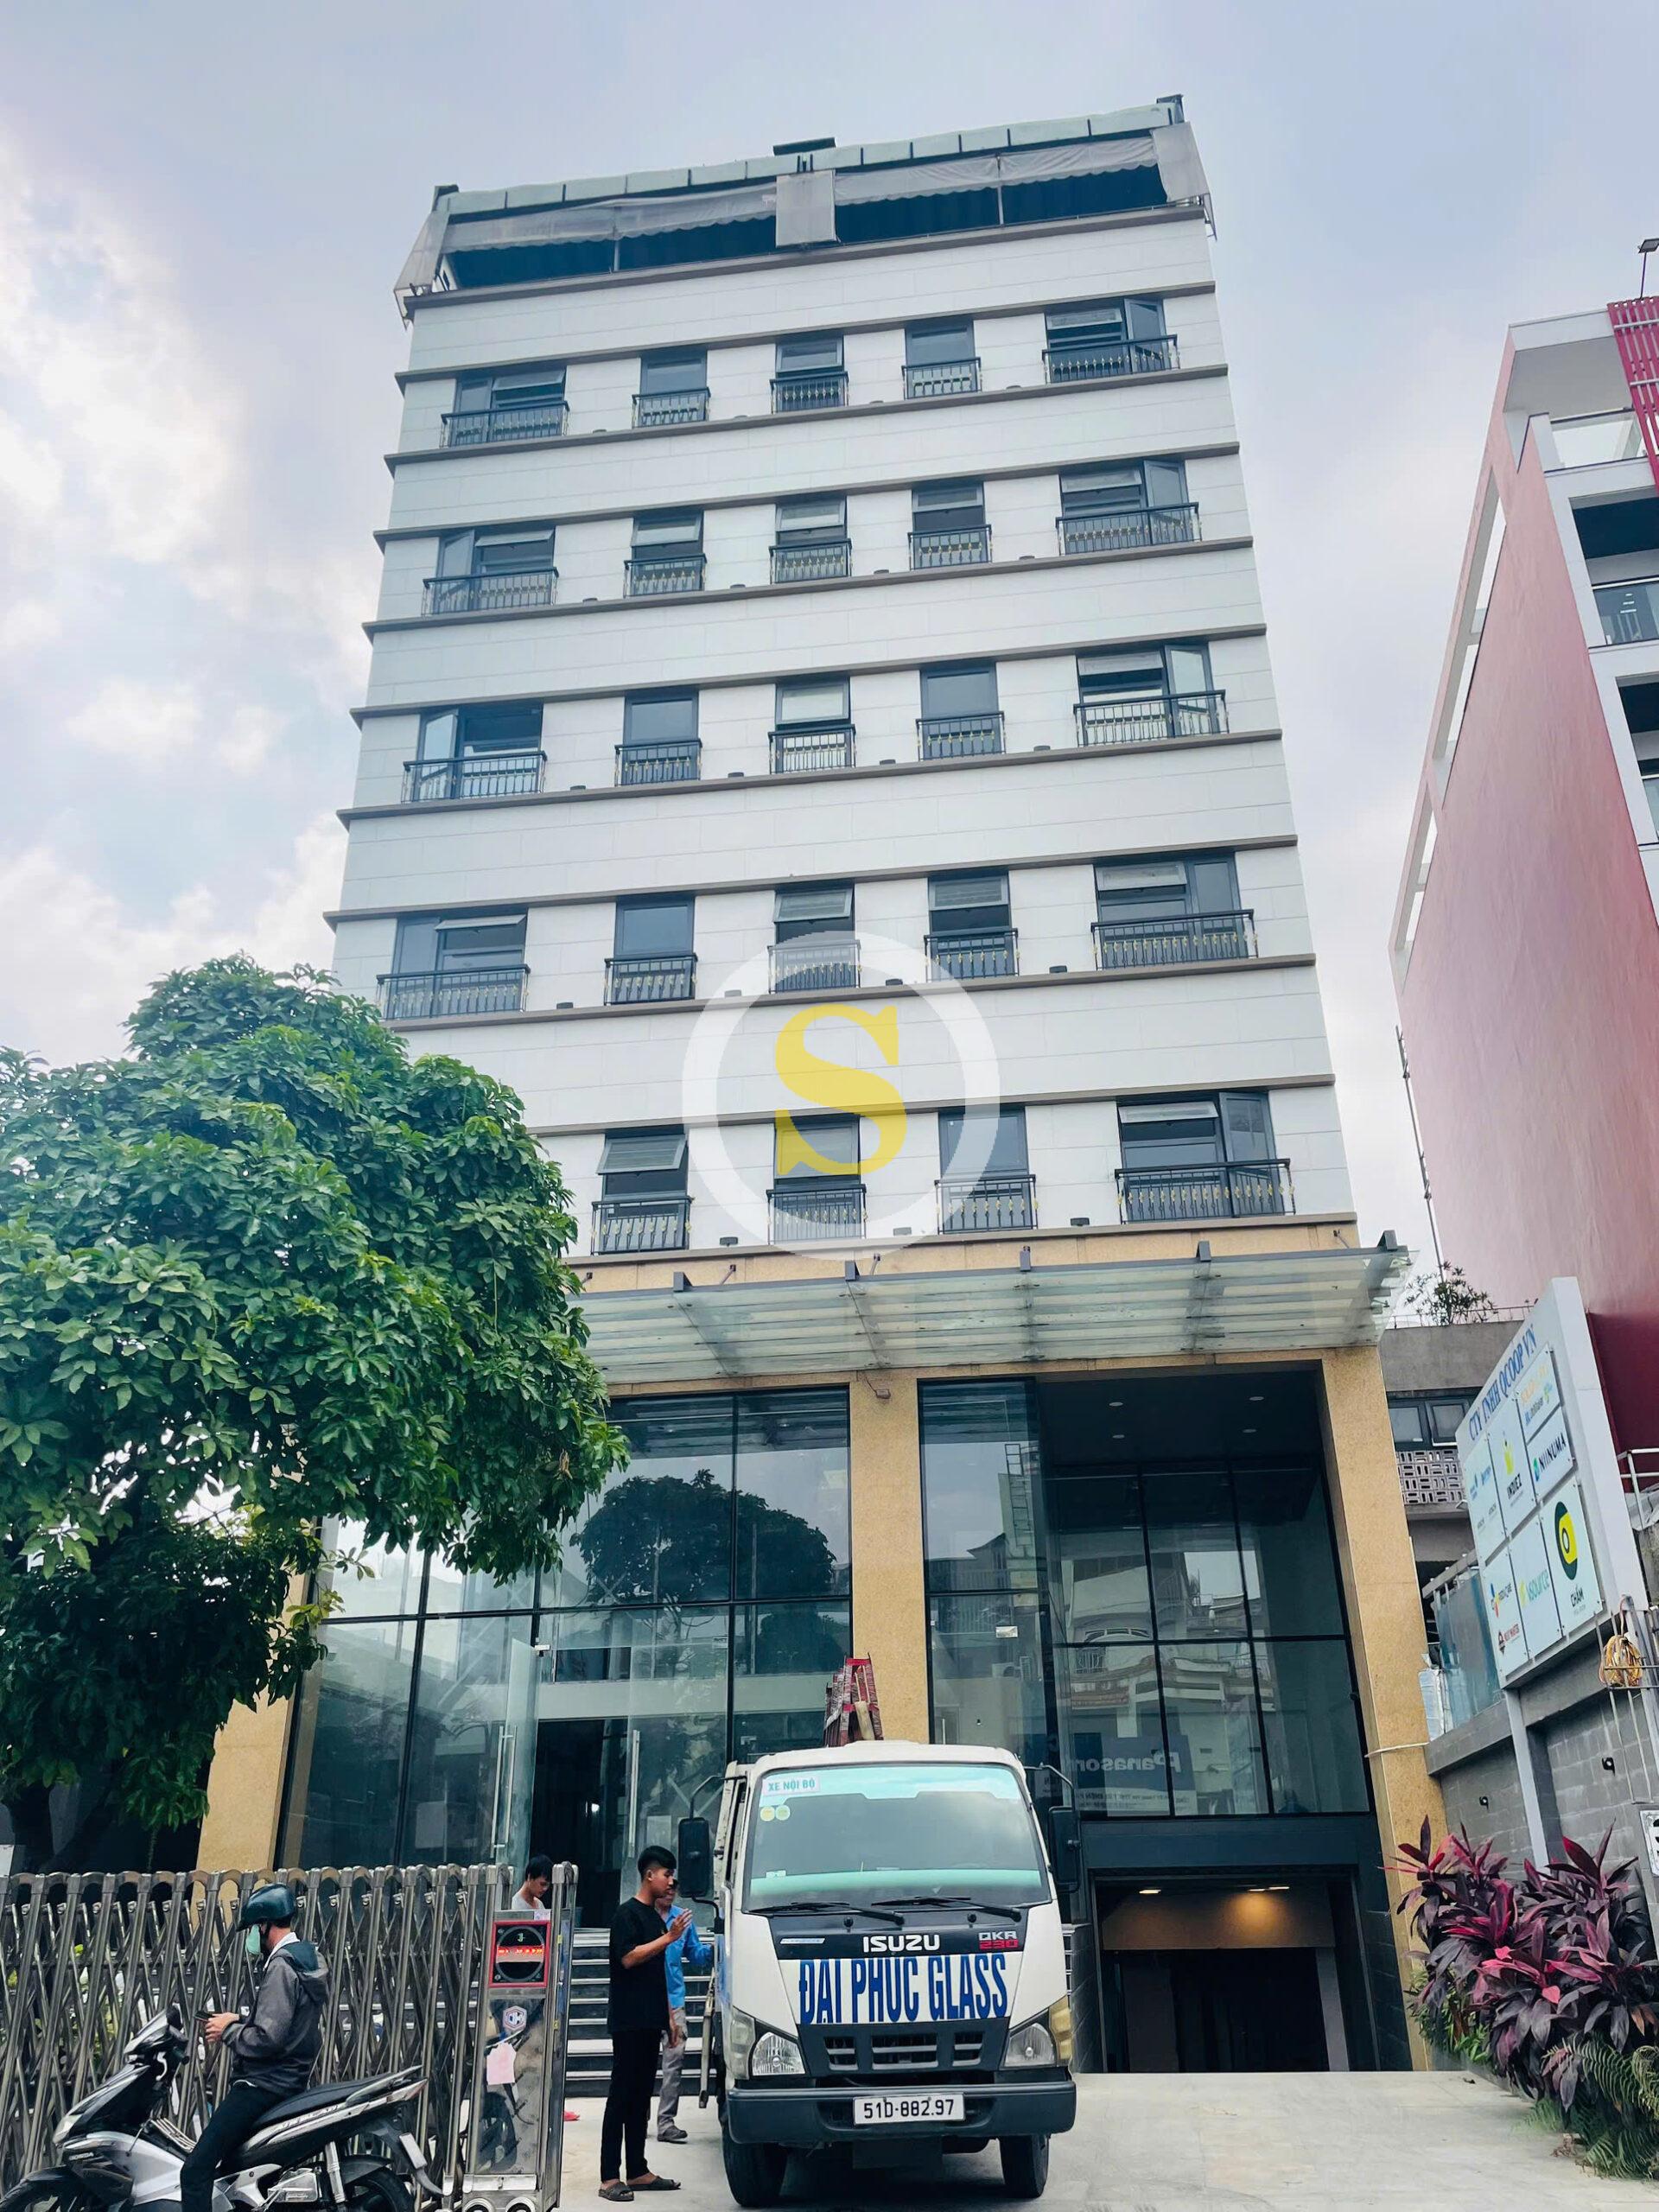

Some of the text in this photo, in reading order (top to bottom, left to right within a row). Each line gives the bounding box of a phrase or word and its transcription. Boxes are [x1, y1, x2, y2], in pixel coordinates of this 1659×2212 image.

[1469, 1408, 1483, 1441] CTY
[1482, 1379, 1502, 1423] TNHH
[1499, 1342, 1524, 1398] QCOOP
[1522, 1324, 1537, 1358] VN
[1538, 1432, 1567, 1472] NIINUMA
[768, 1777, 816, 1791] XE NỘI BỘ
[862, 1934, 940, 1953] ISUZU
[979, 1939, 1019, 1949] 230
[926, 1951, 1008, 2022] GLASS
[864, 2099, 954, 2119] 51D-882.97
